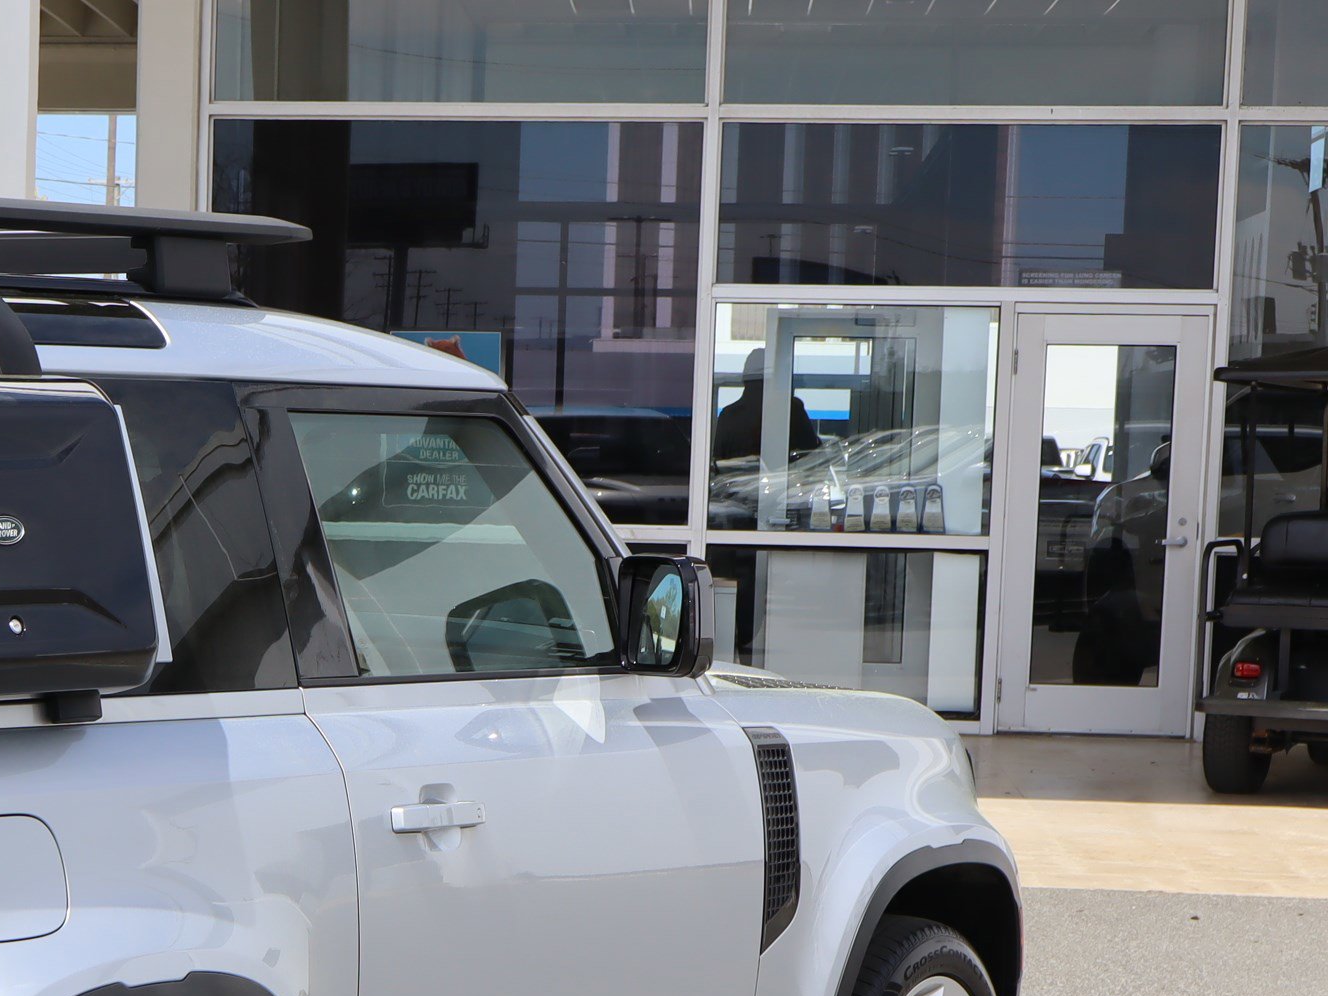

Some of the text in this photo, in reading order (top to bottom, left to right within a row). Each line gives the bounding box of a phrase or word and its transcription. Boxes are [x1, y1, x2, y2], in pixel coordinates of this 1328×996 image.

[408, 436, 460, 450] ADVANTA
[419, 448, 459, 461] DEALER
[407, 472, 467, 485] SHOW ME THE
[406, 484, 468, 500] CARFAX
